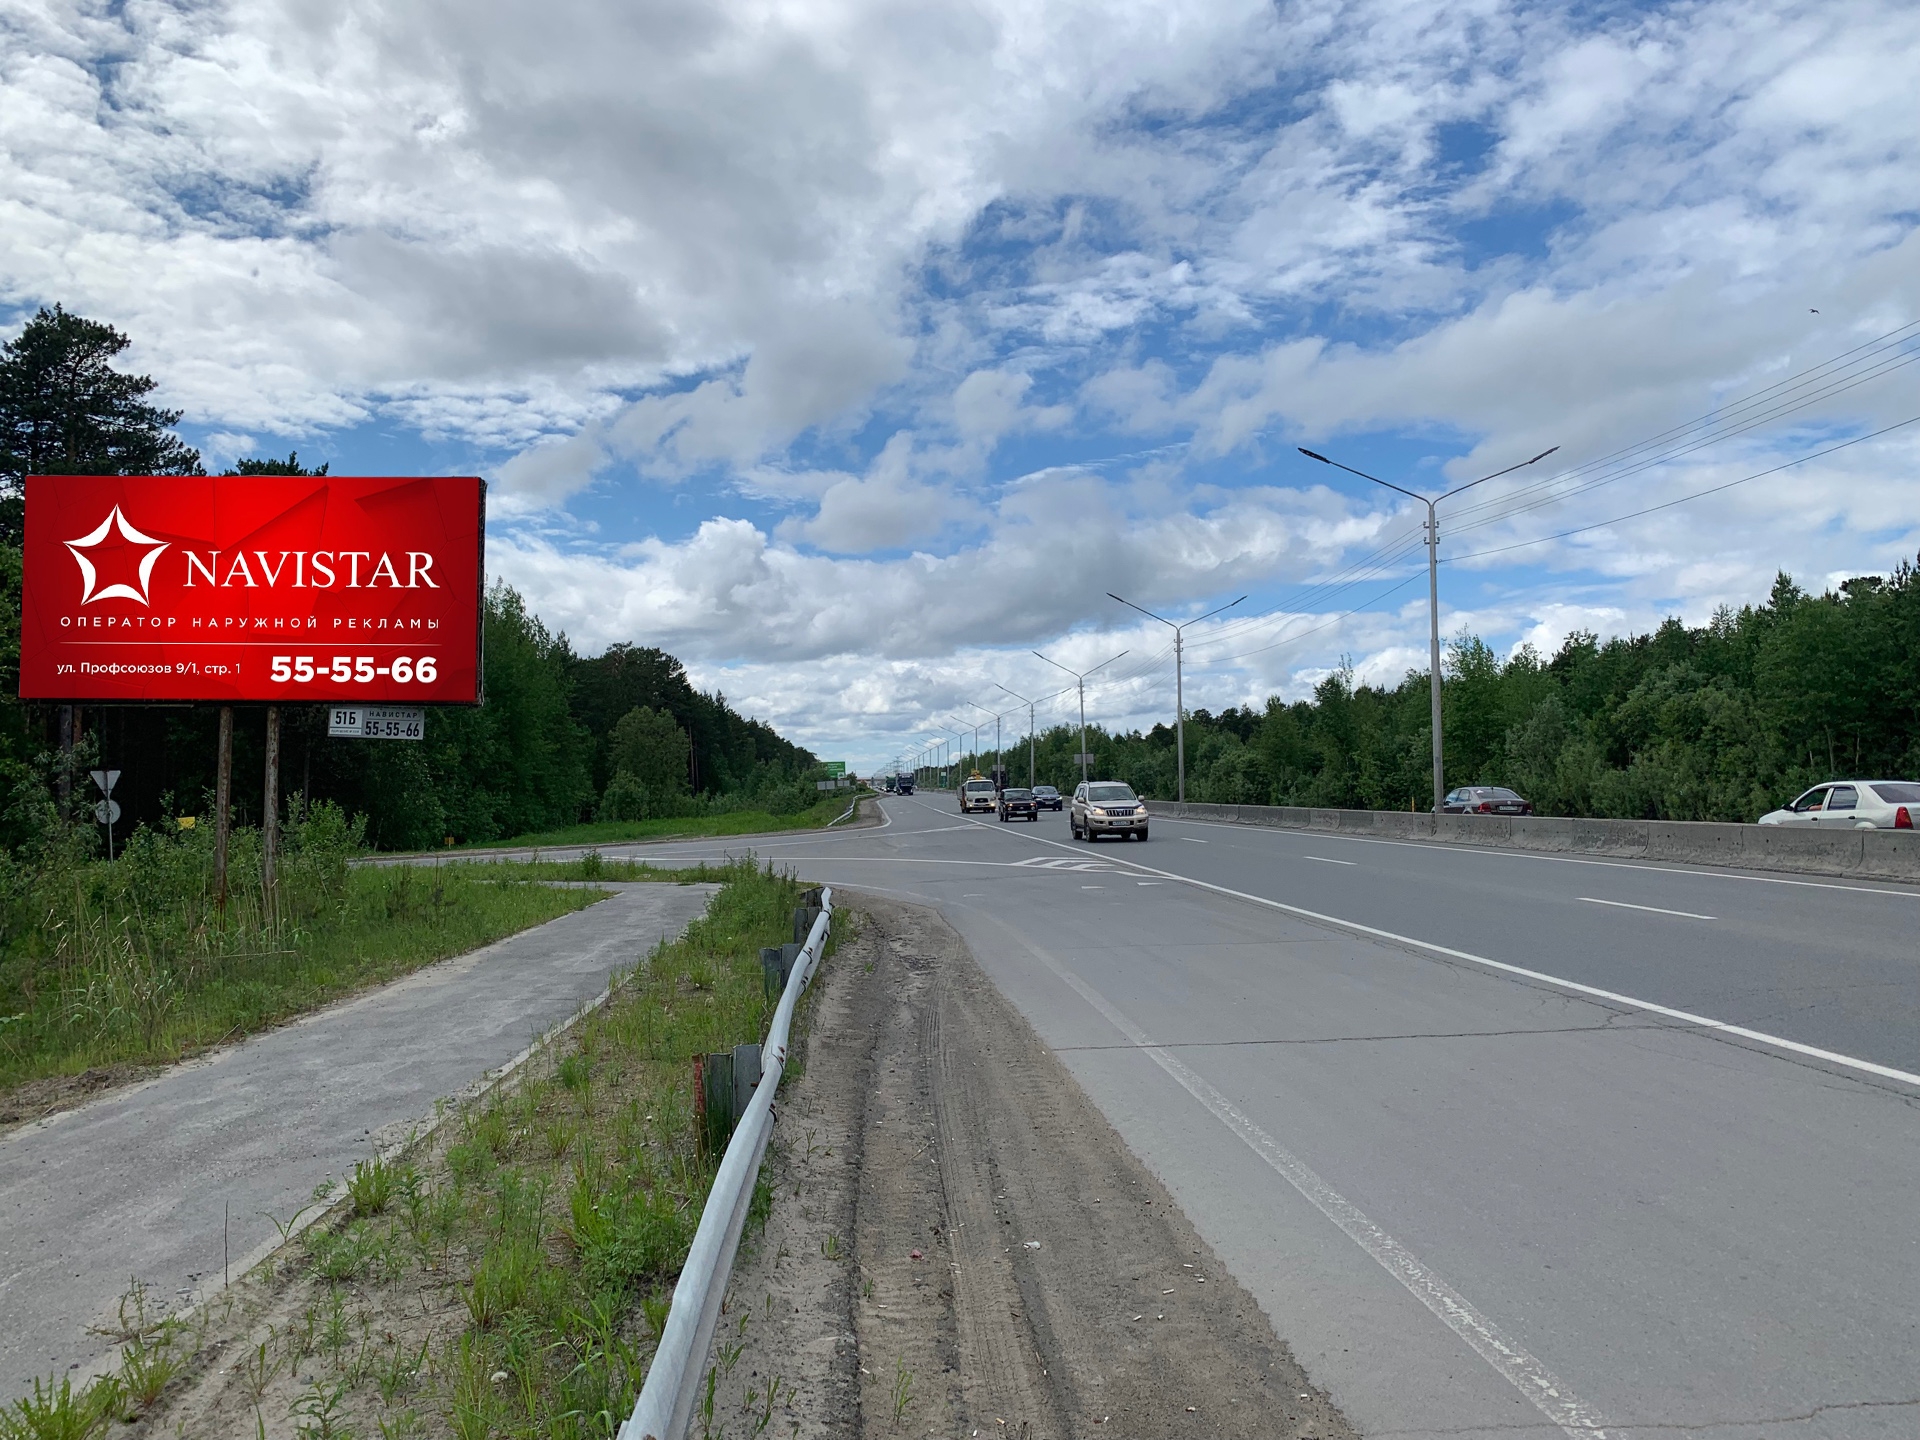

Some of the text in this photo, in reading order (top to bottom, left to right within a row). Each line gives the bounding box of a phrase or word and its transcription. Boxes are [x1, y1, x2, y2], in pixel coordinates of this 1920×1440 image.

[182, 551, 440, 589] NAVISTAR
[60, 615, 440, 629] ОПЕРАТОР НАРУЖНОЙ РЕКЛАМЫ
[57, 661, 241, 677] ул. Профсоюзов 9/1, стр. 1
[270, 655, 438, 684] 55-55-66
[335, 711, 356, 725] 51Б
[365, 721, 420, 737] 55-55-66
